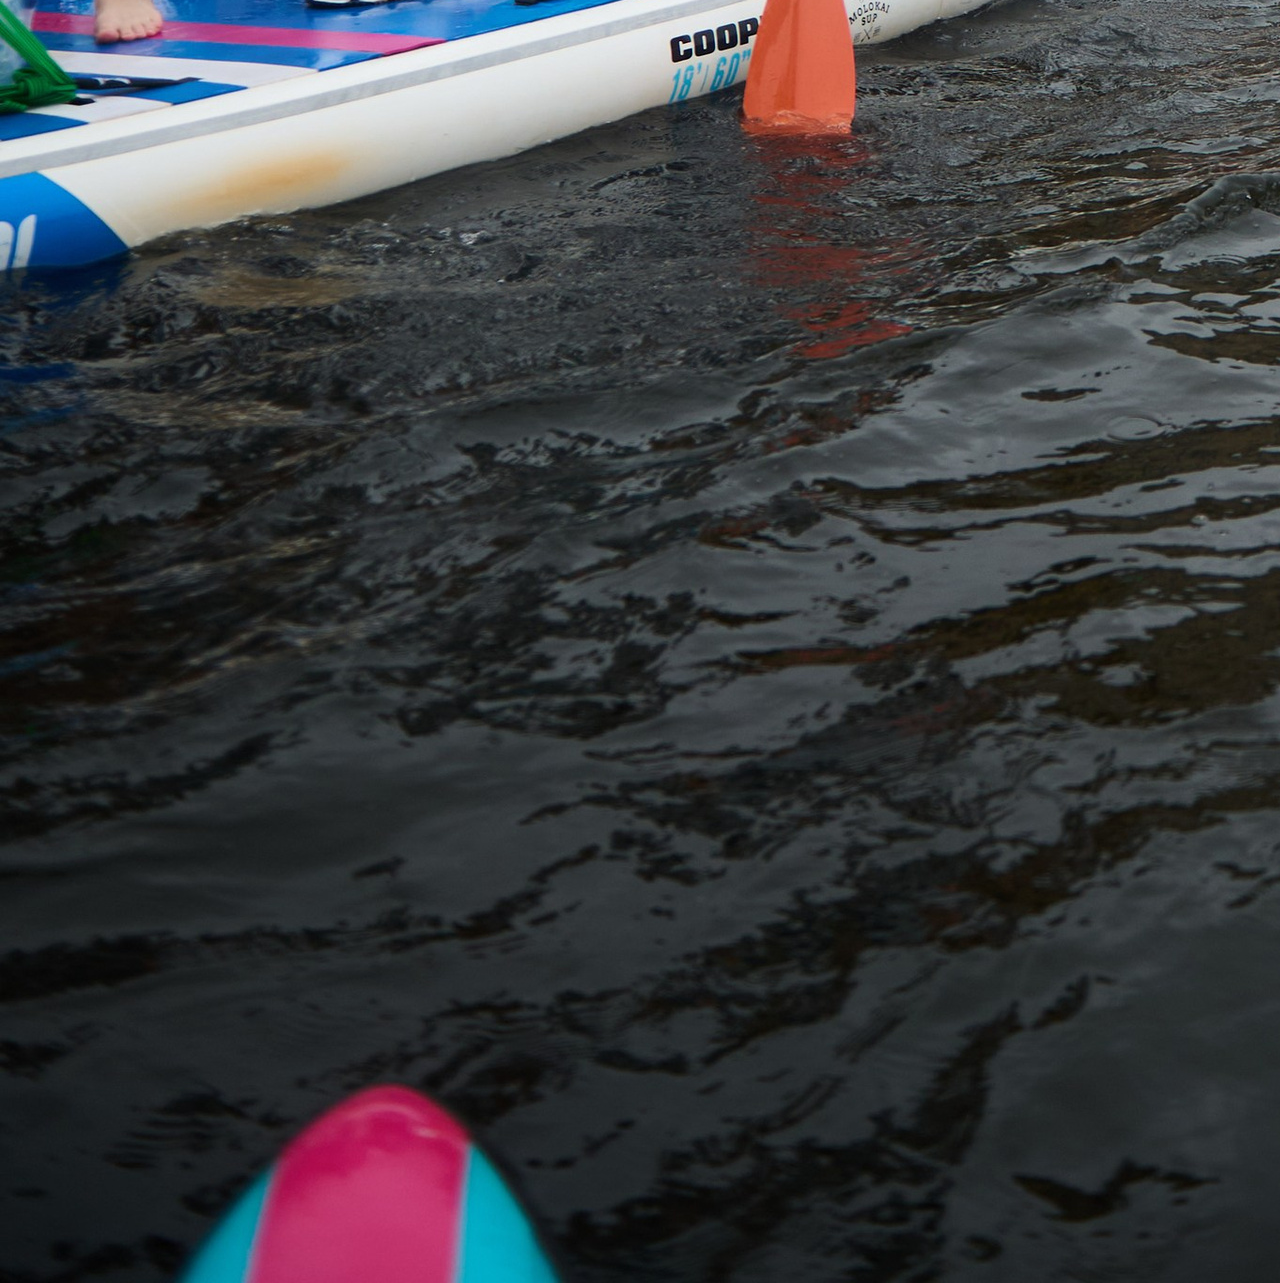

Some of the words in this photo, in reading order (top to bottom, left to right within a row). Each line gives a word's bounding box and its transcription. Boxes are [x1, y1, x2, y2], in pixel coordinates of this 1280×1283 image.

[849, 1, 890, 25] MOLOKAI
[861, 13, 878, 26] SUP
[670, 15, 763, 63] COOP
